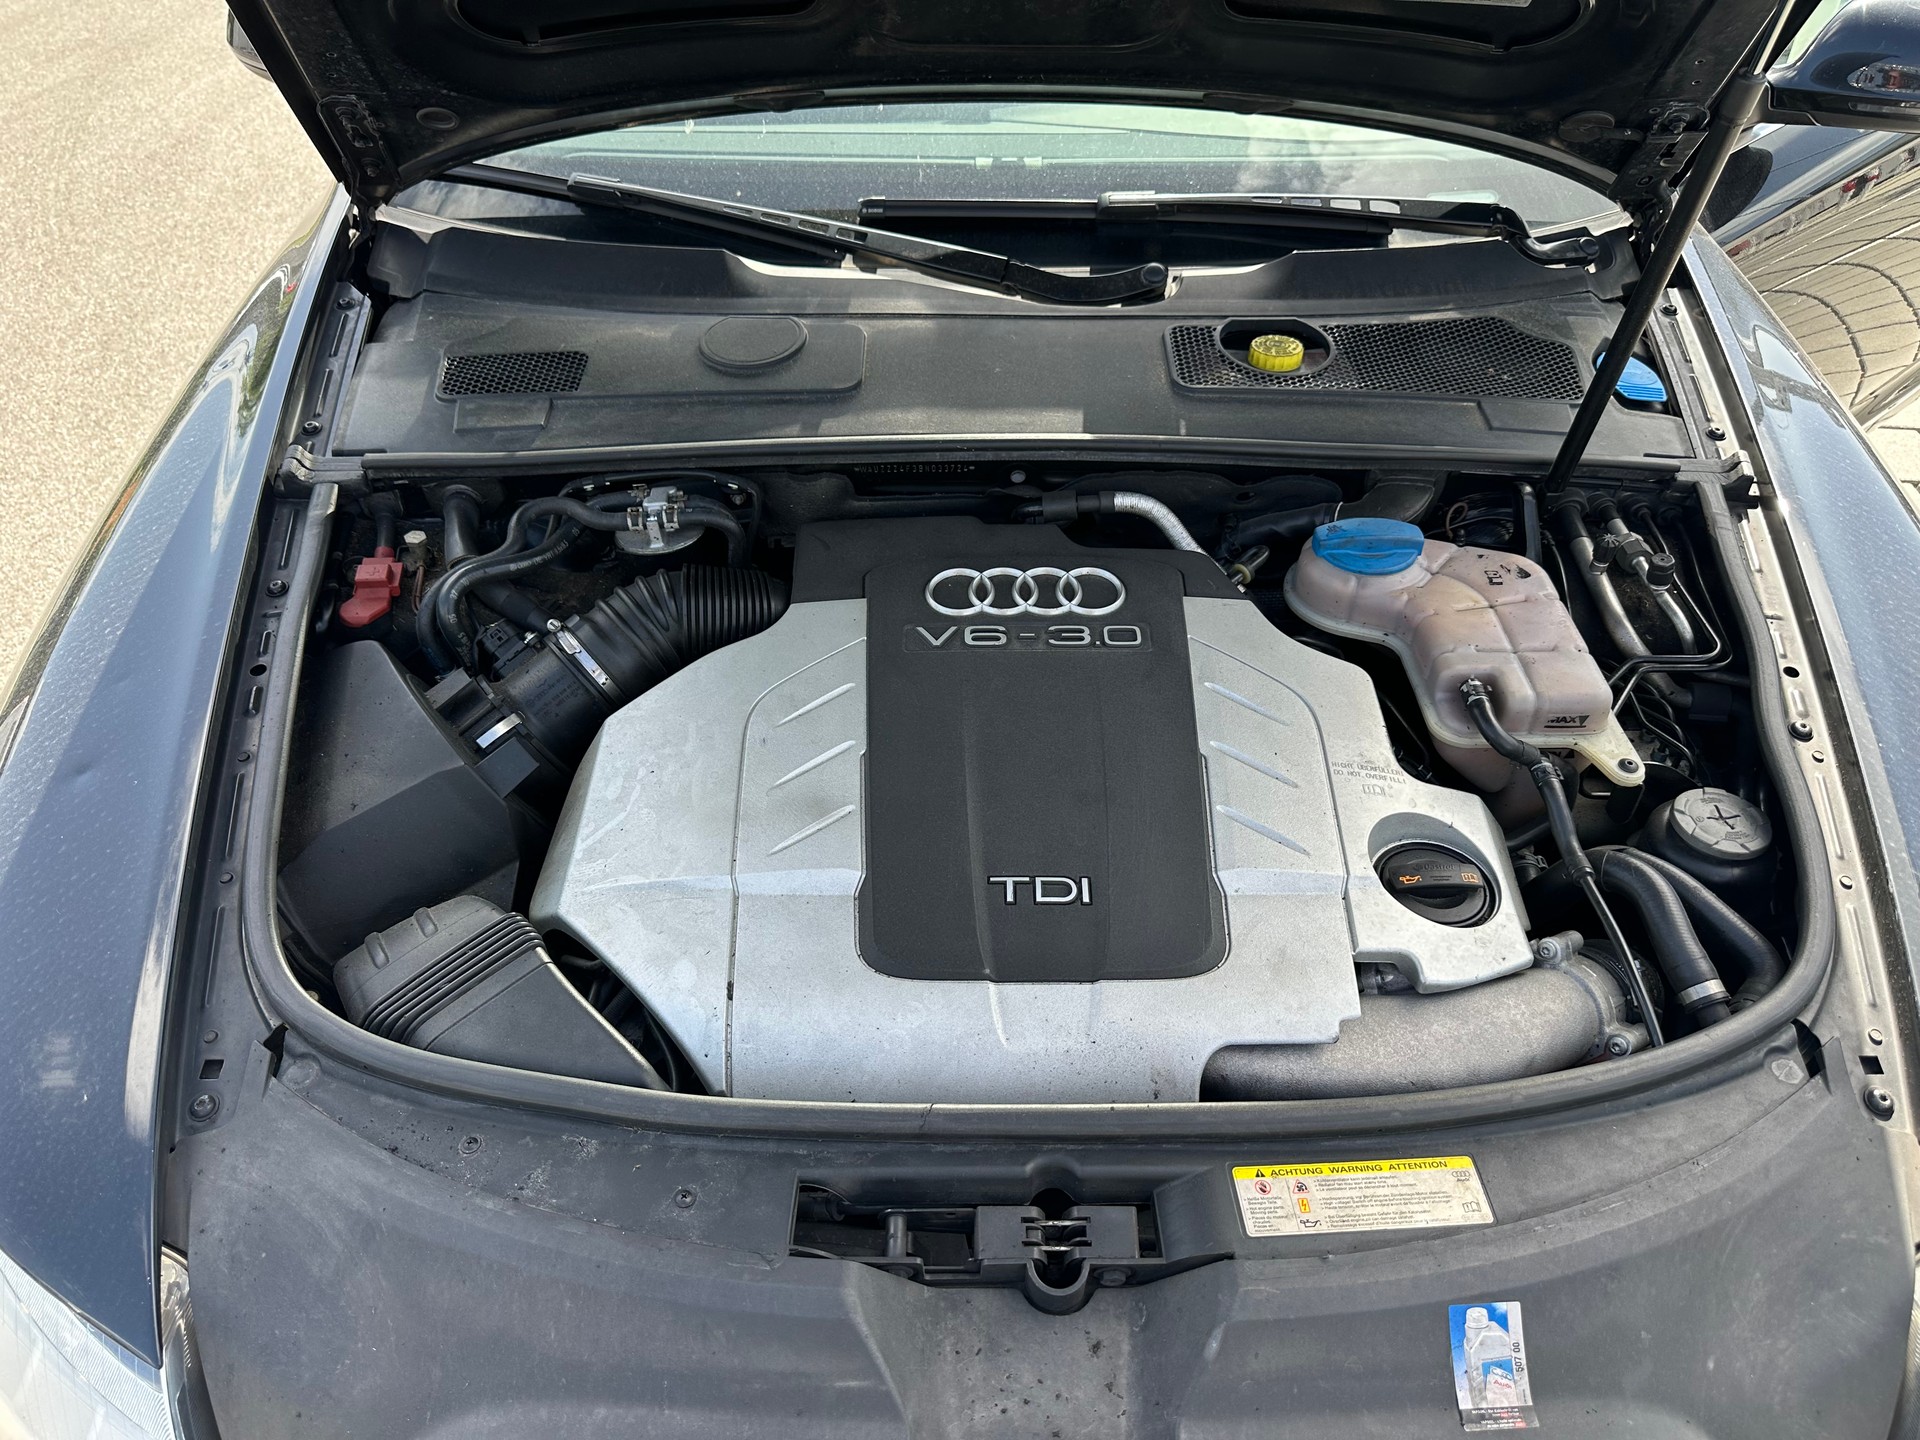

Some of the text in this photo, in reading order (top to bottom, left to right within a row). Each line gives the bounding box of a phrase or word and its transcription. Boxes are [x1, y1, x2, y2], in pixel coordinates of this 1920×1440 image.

[988, 876, 1092, 904] TDI
[1270, 1160, 1448, 1177] ACHTUNG WARNING ATTENTION
[1512, 1342, 1520, 1352] 00
